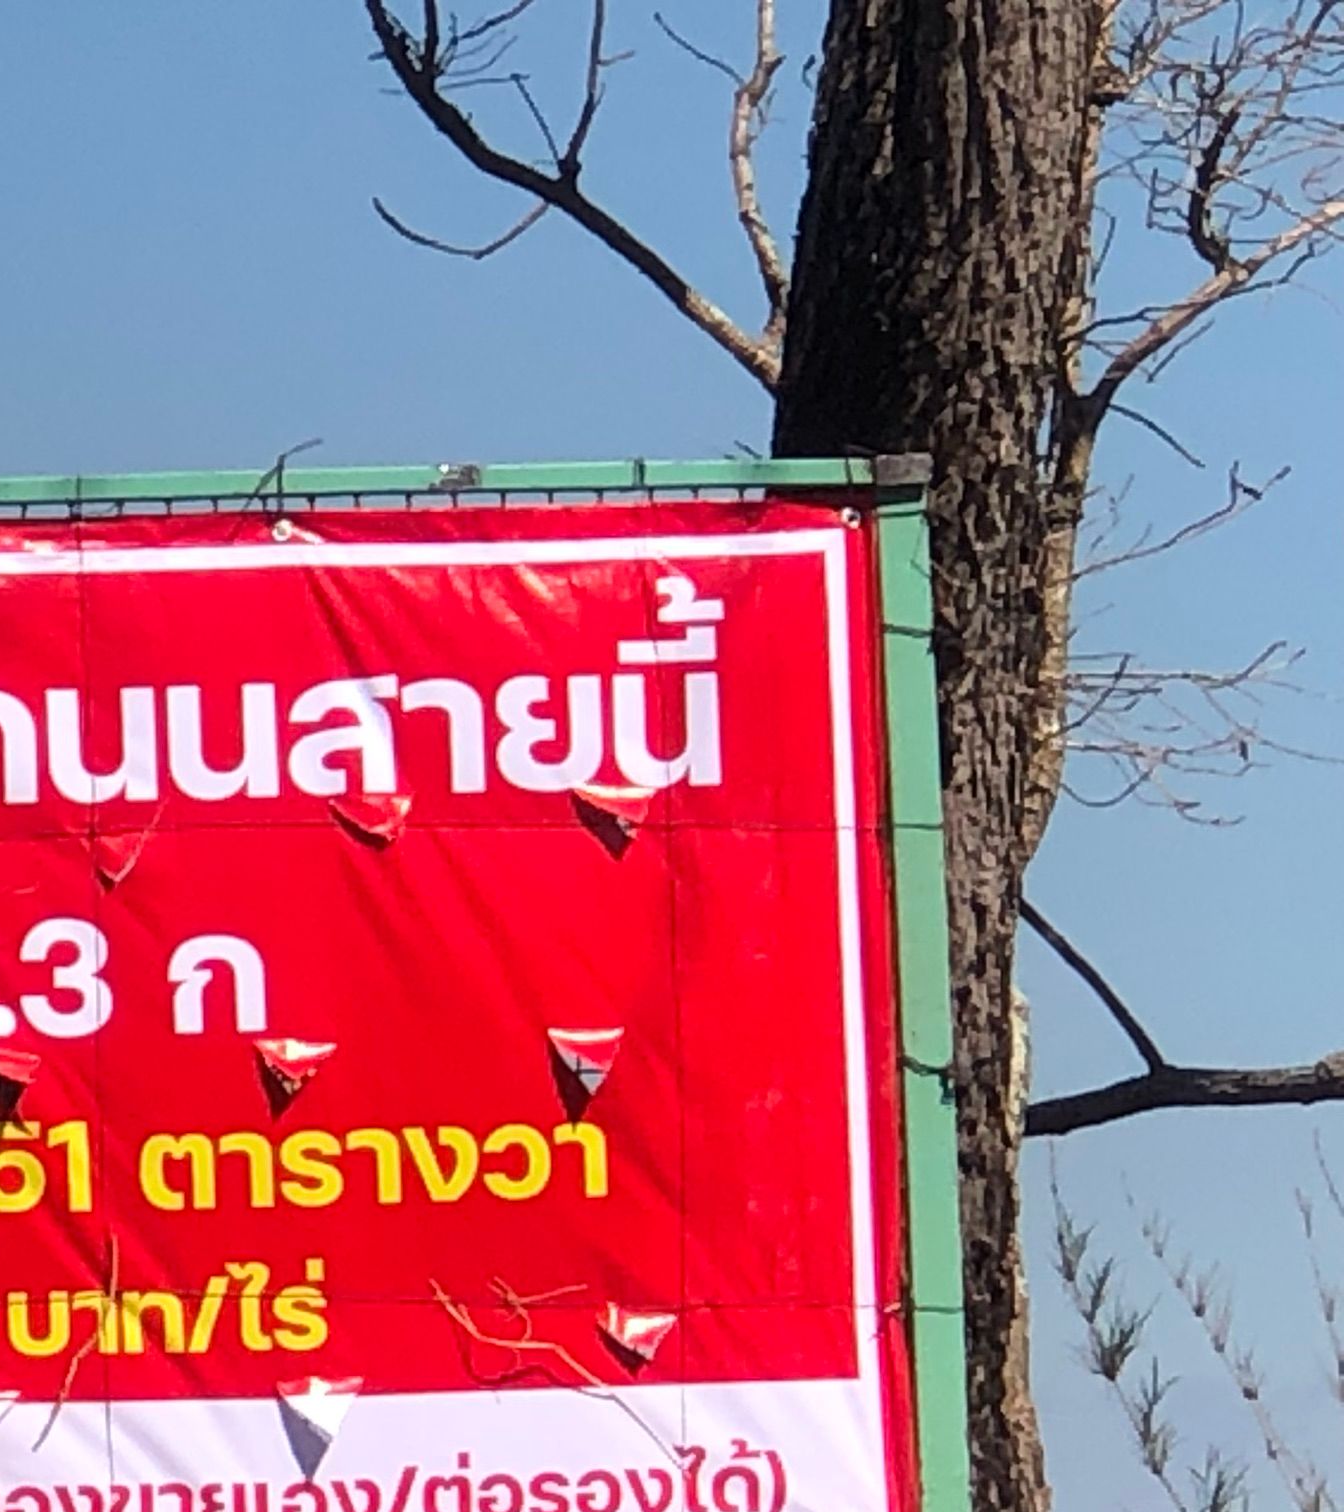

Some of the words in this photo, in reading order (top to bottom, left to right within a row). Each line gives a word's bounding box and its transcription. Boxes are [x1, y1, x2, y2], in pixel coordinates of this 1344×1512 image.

[168, 935, 271, 1036] ก
[138, 1121, 609, 1211] ตารางวา
[6, 1258, 329, 1357] บาท/ไร่
